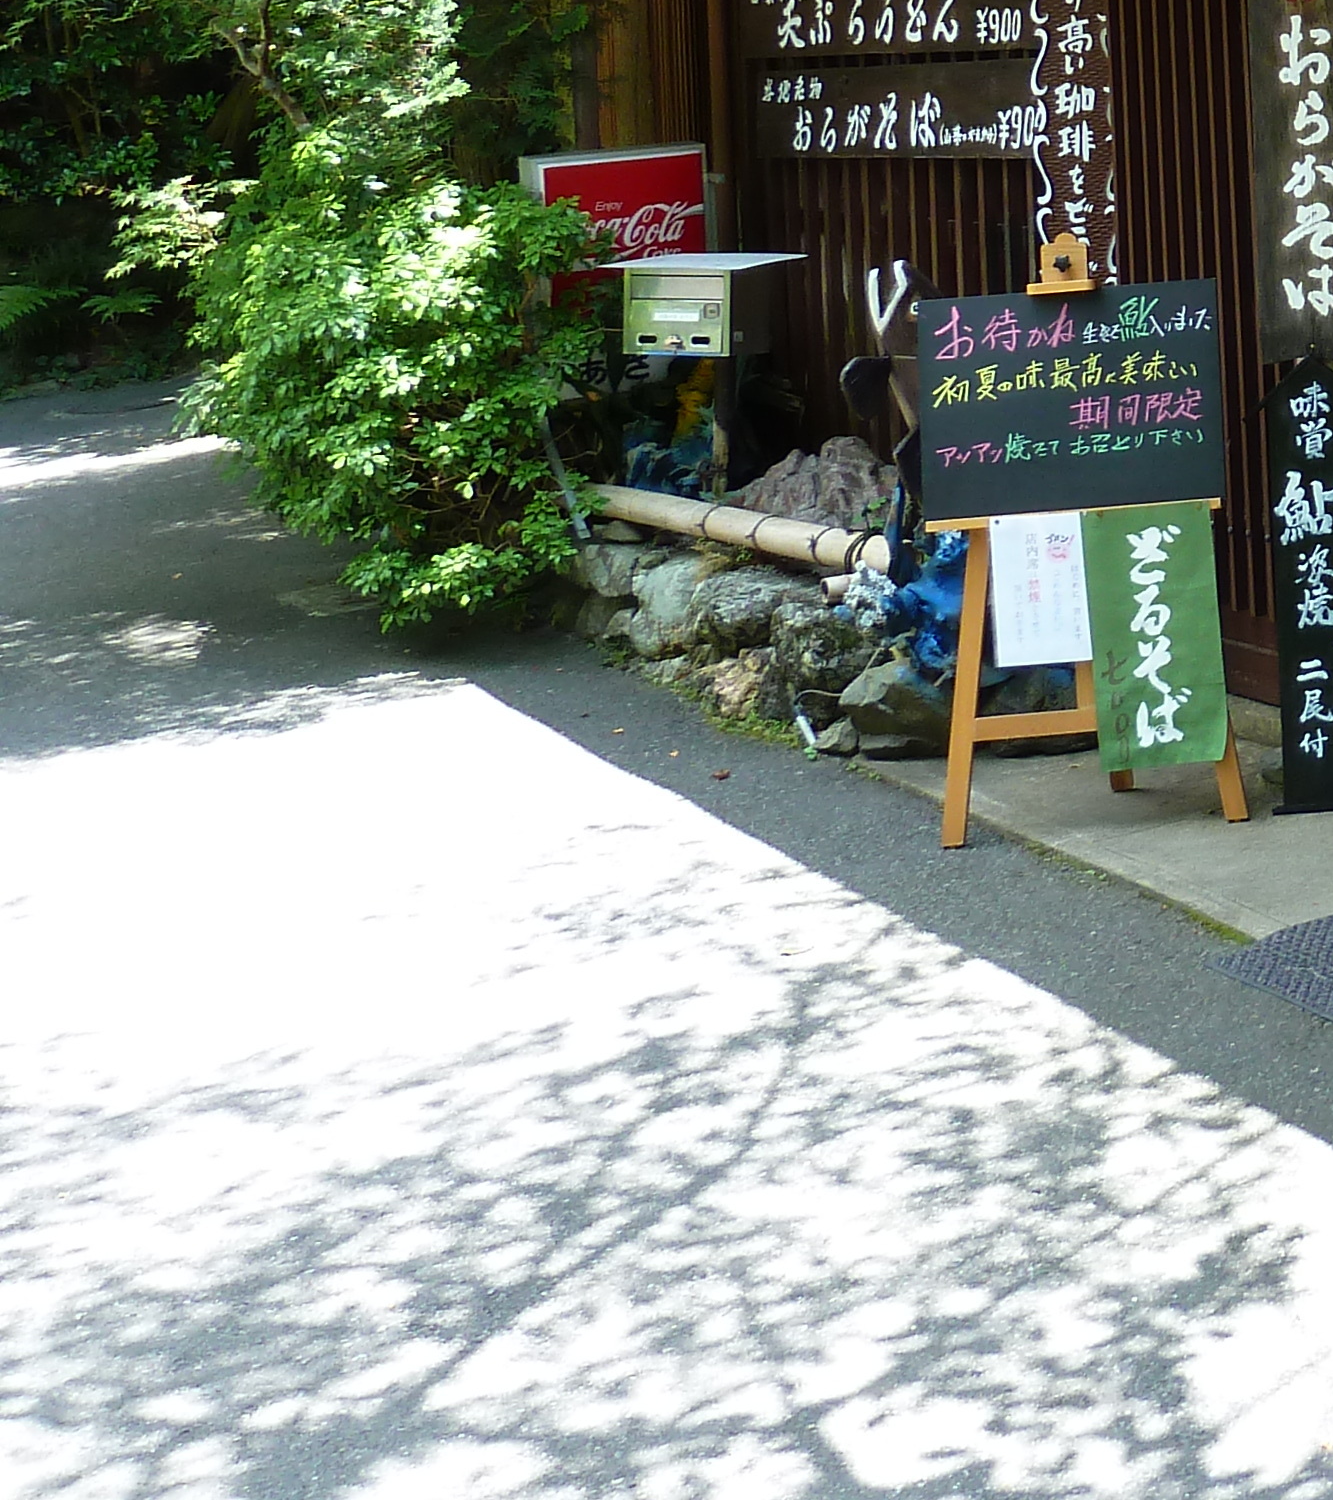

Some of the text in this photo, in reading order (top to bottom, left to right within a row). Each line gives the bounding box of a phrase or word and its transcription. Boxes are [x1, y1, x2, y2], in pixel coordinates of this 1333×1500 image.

[976, 5, 1023, 45] ¥900
[792, 91, 941, 154] おらがそば
[594, 201, 624, 213] Enjoy
[934, 302, 1076, 361] お待かね
[1068, 386, 1205, 431] 期間限定
[1124, 523, 1196, 749] ざるそば
[1296, 658, 1333, 759] 二尾付
